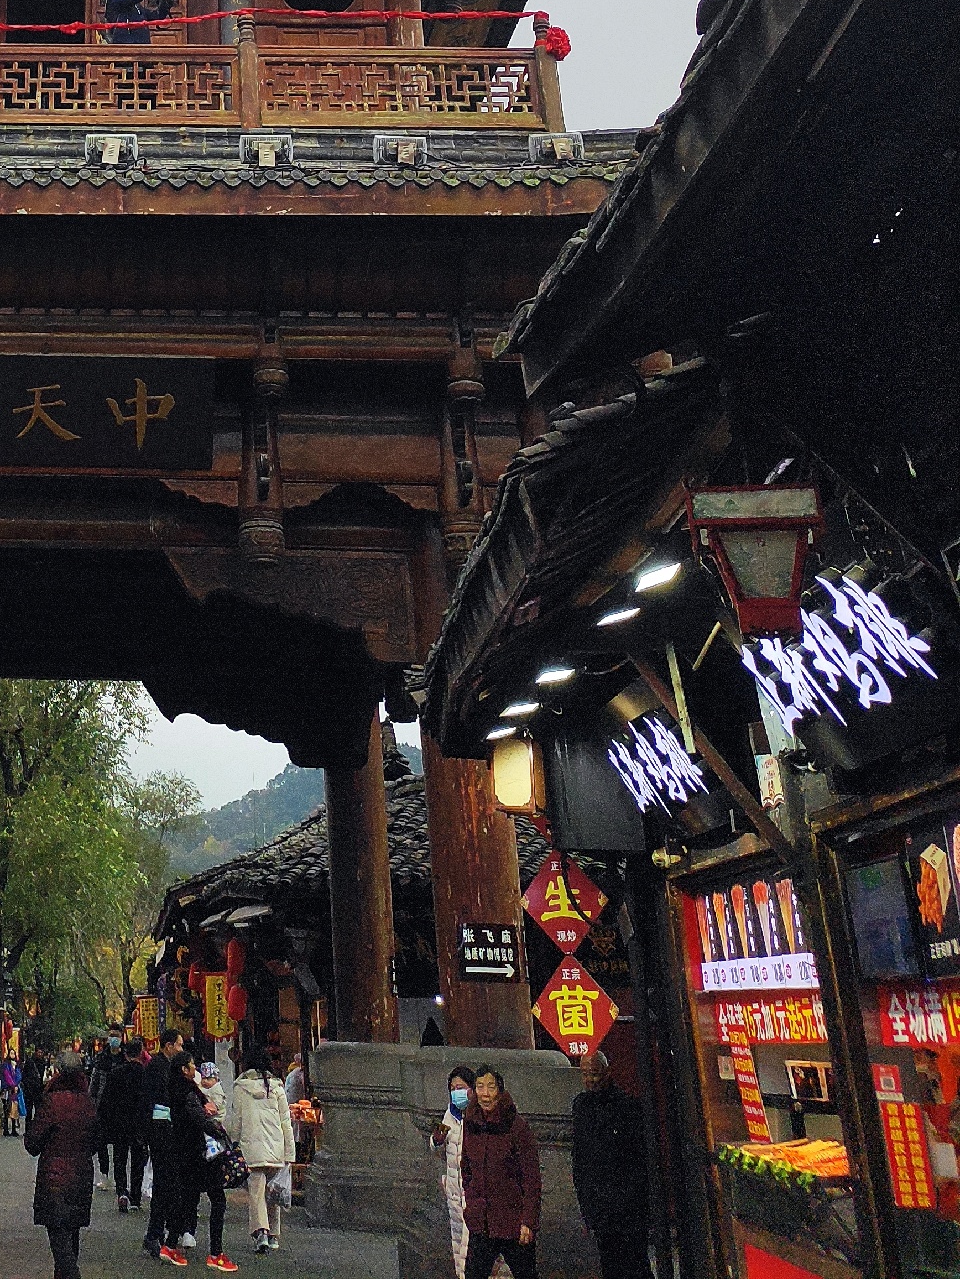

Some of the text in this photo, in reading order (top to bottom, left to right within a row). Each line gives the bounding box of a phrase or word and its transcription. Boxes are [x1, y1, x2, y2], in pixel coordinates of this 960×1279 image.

[541, 876, 592, 921] 生
[462, 928, 512, 944] 张飞庙
[556, 930, 577, 942] 现炒
[561, 969, 581, 980] 正宗
[548, 985, 600, 1036] 菌
[568, 1042, 589, 1055] 现炒
